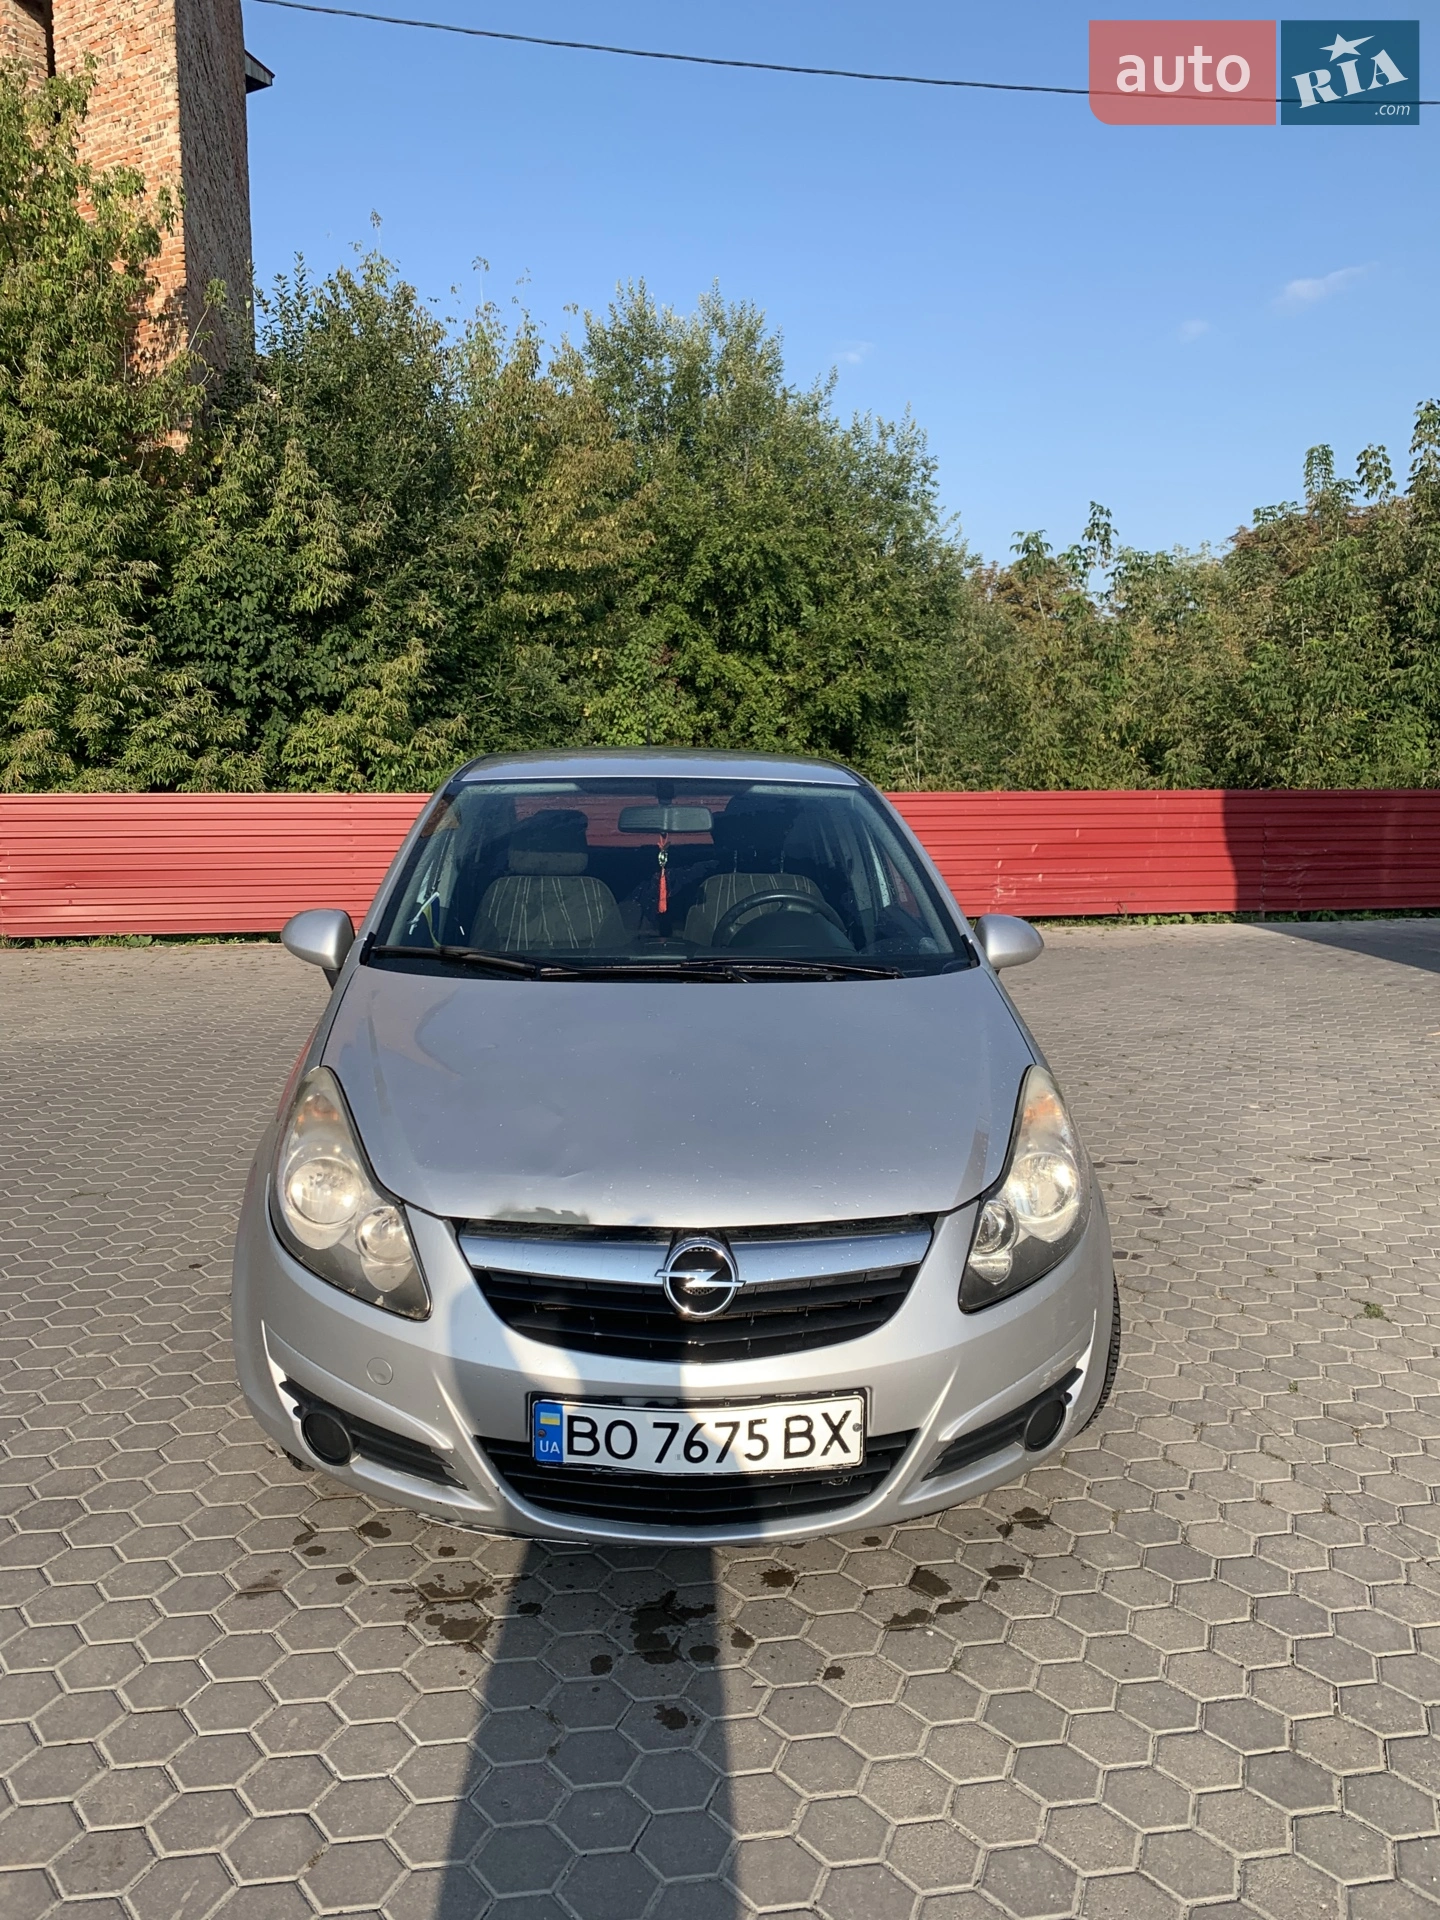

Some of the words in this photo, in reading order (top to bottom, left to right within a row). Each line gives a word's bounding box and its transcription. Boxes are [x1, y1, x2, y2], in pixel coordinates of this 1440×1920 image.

[539, 1440, 560, 1455] UA
[566, 1414, 638, 1460] BO
[652, 1417, 769, 1464] 7675
[783, 1410, 853, 1459] BX
